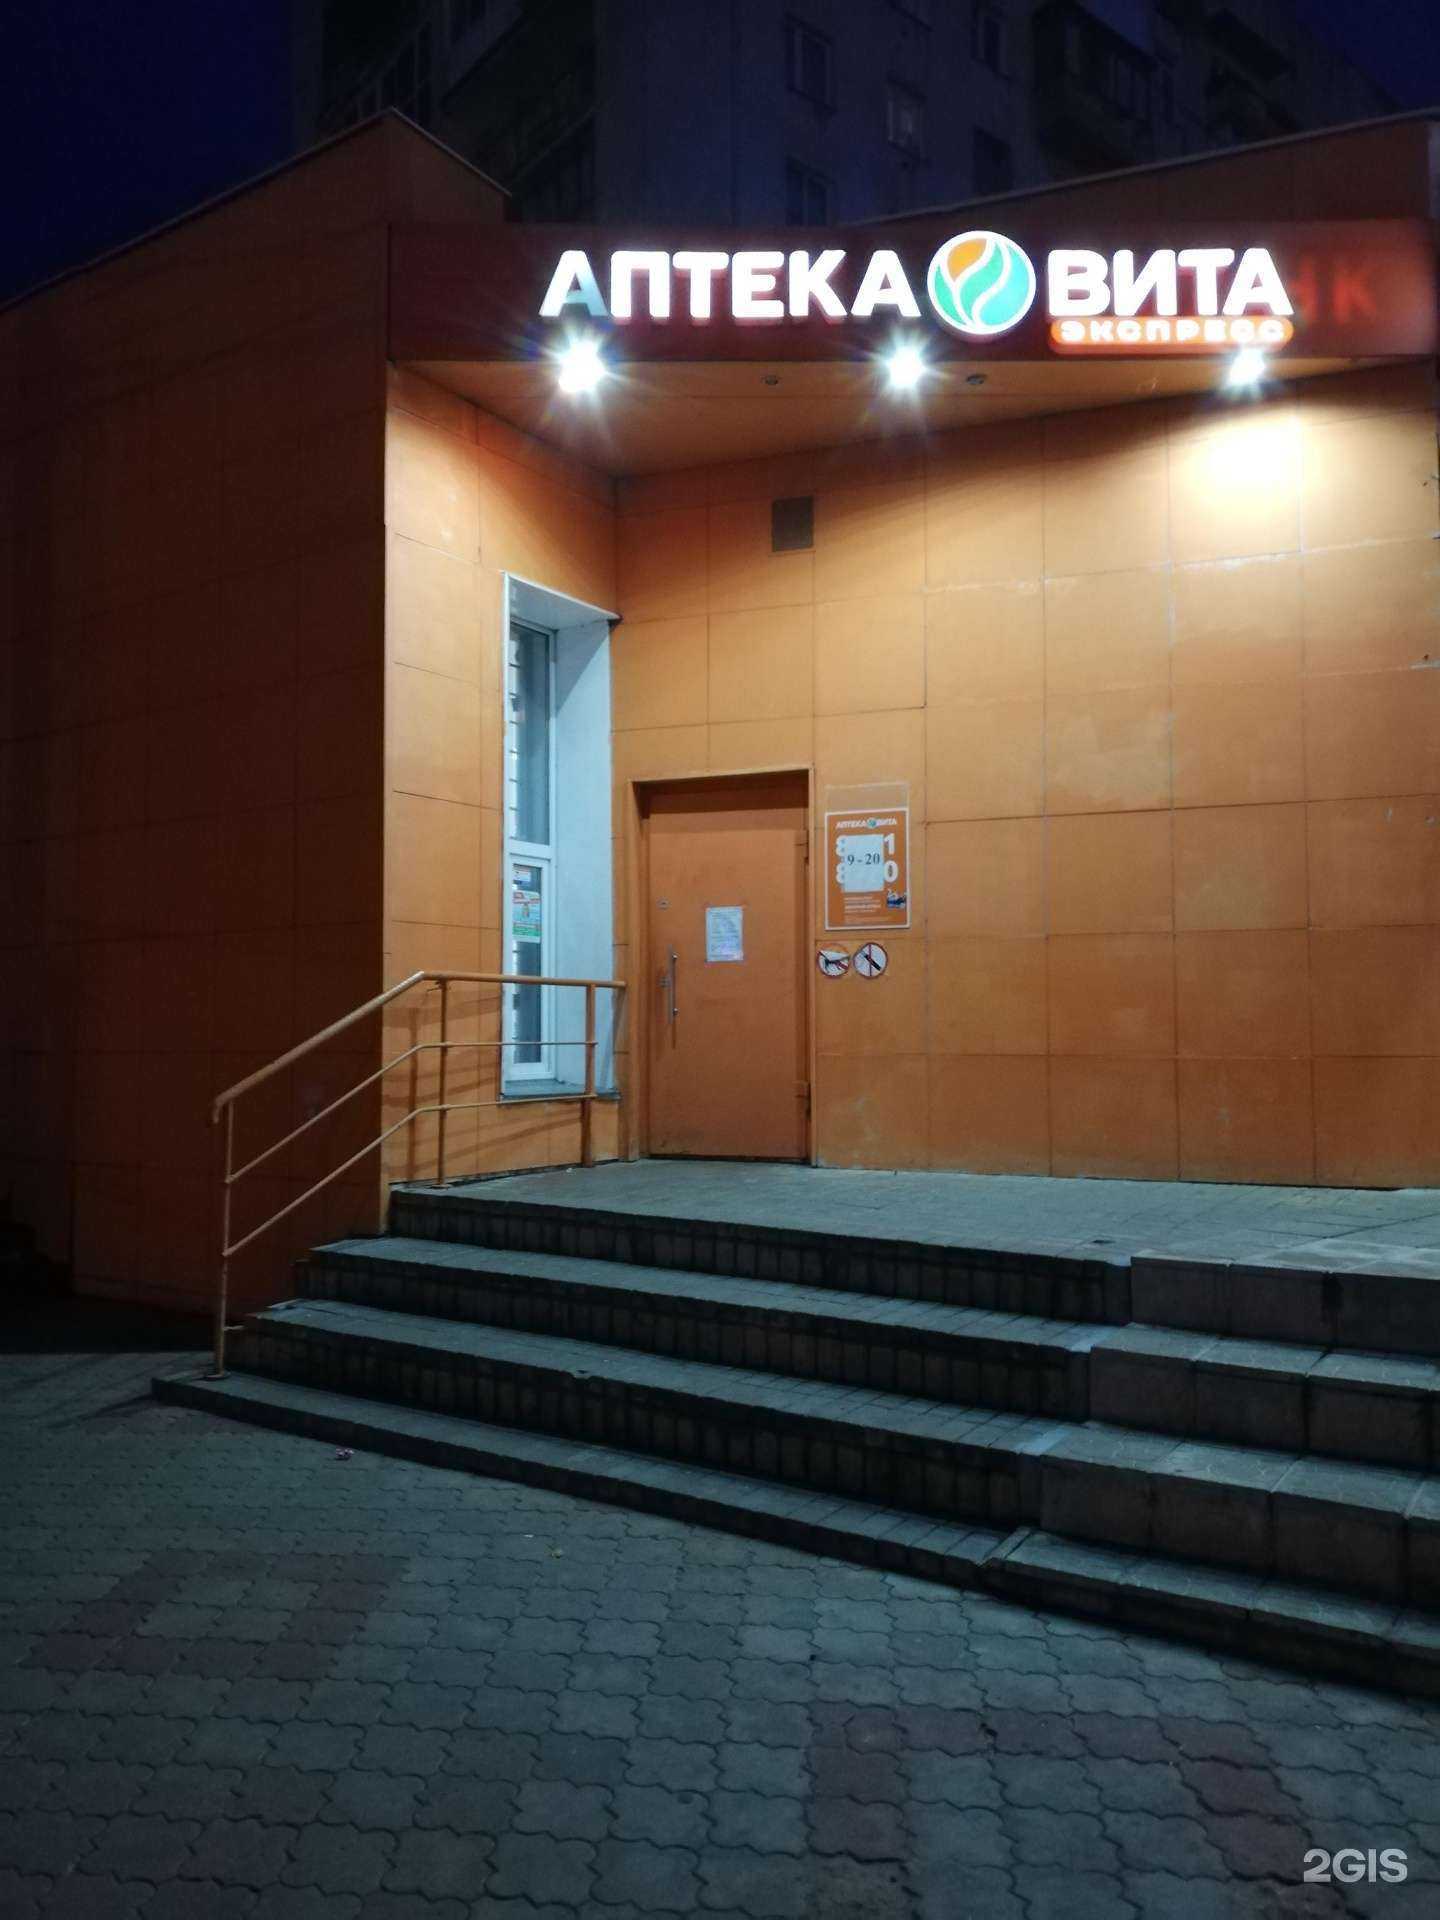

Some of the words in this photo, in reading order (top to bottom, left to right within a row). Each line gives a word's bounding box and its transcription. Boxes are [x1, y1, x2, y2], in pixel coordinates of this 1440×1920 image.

[539, 249, 922, 318] АПТЕКА
[1047, 248, 1294, 317] ВИТА
[1060, 319, 1287, 344] ЭКСПРЕСС
[864, 853, 881, 865] 20
